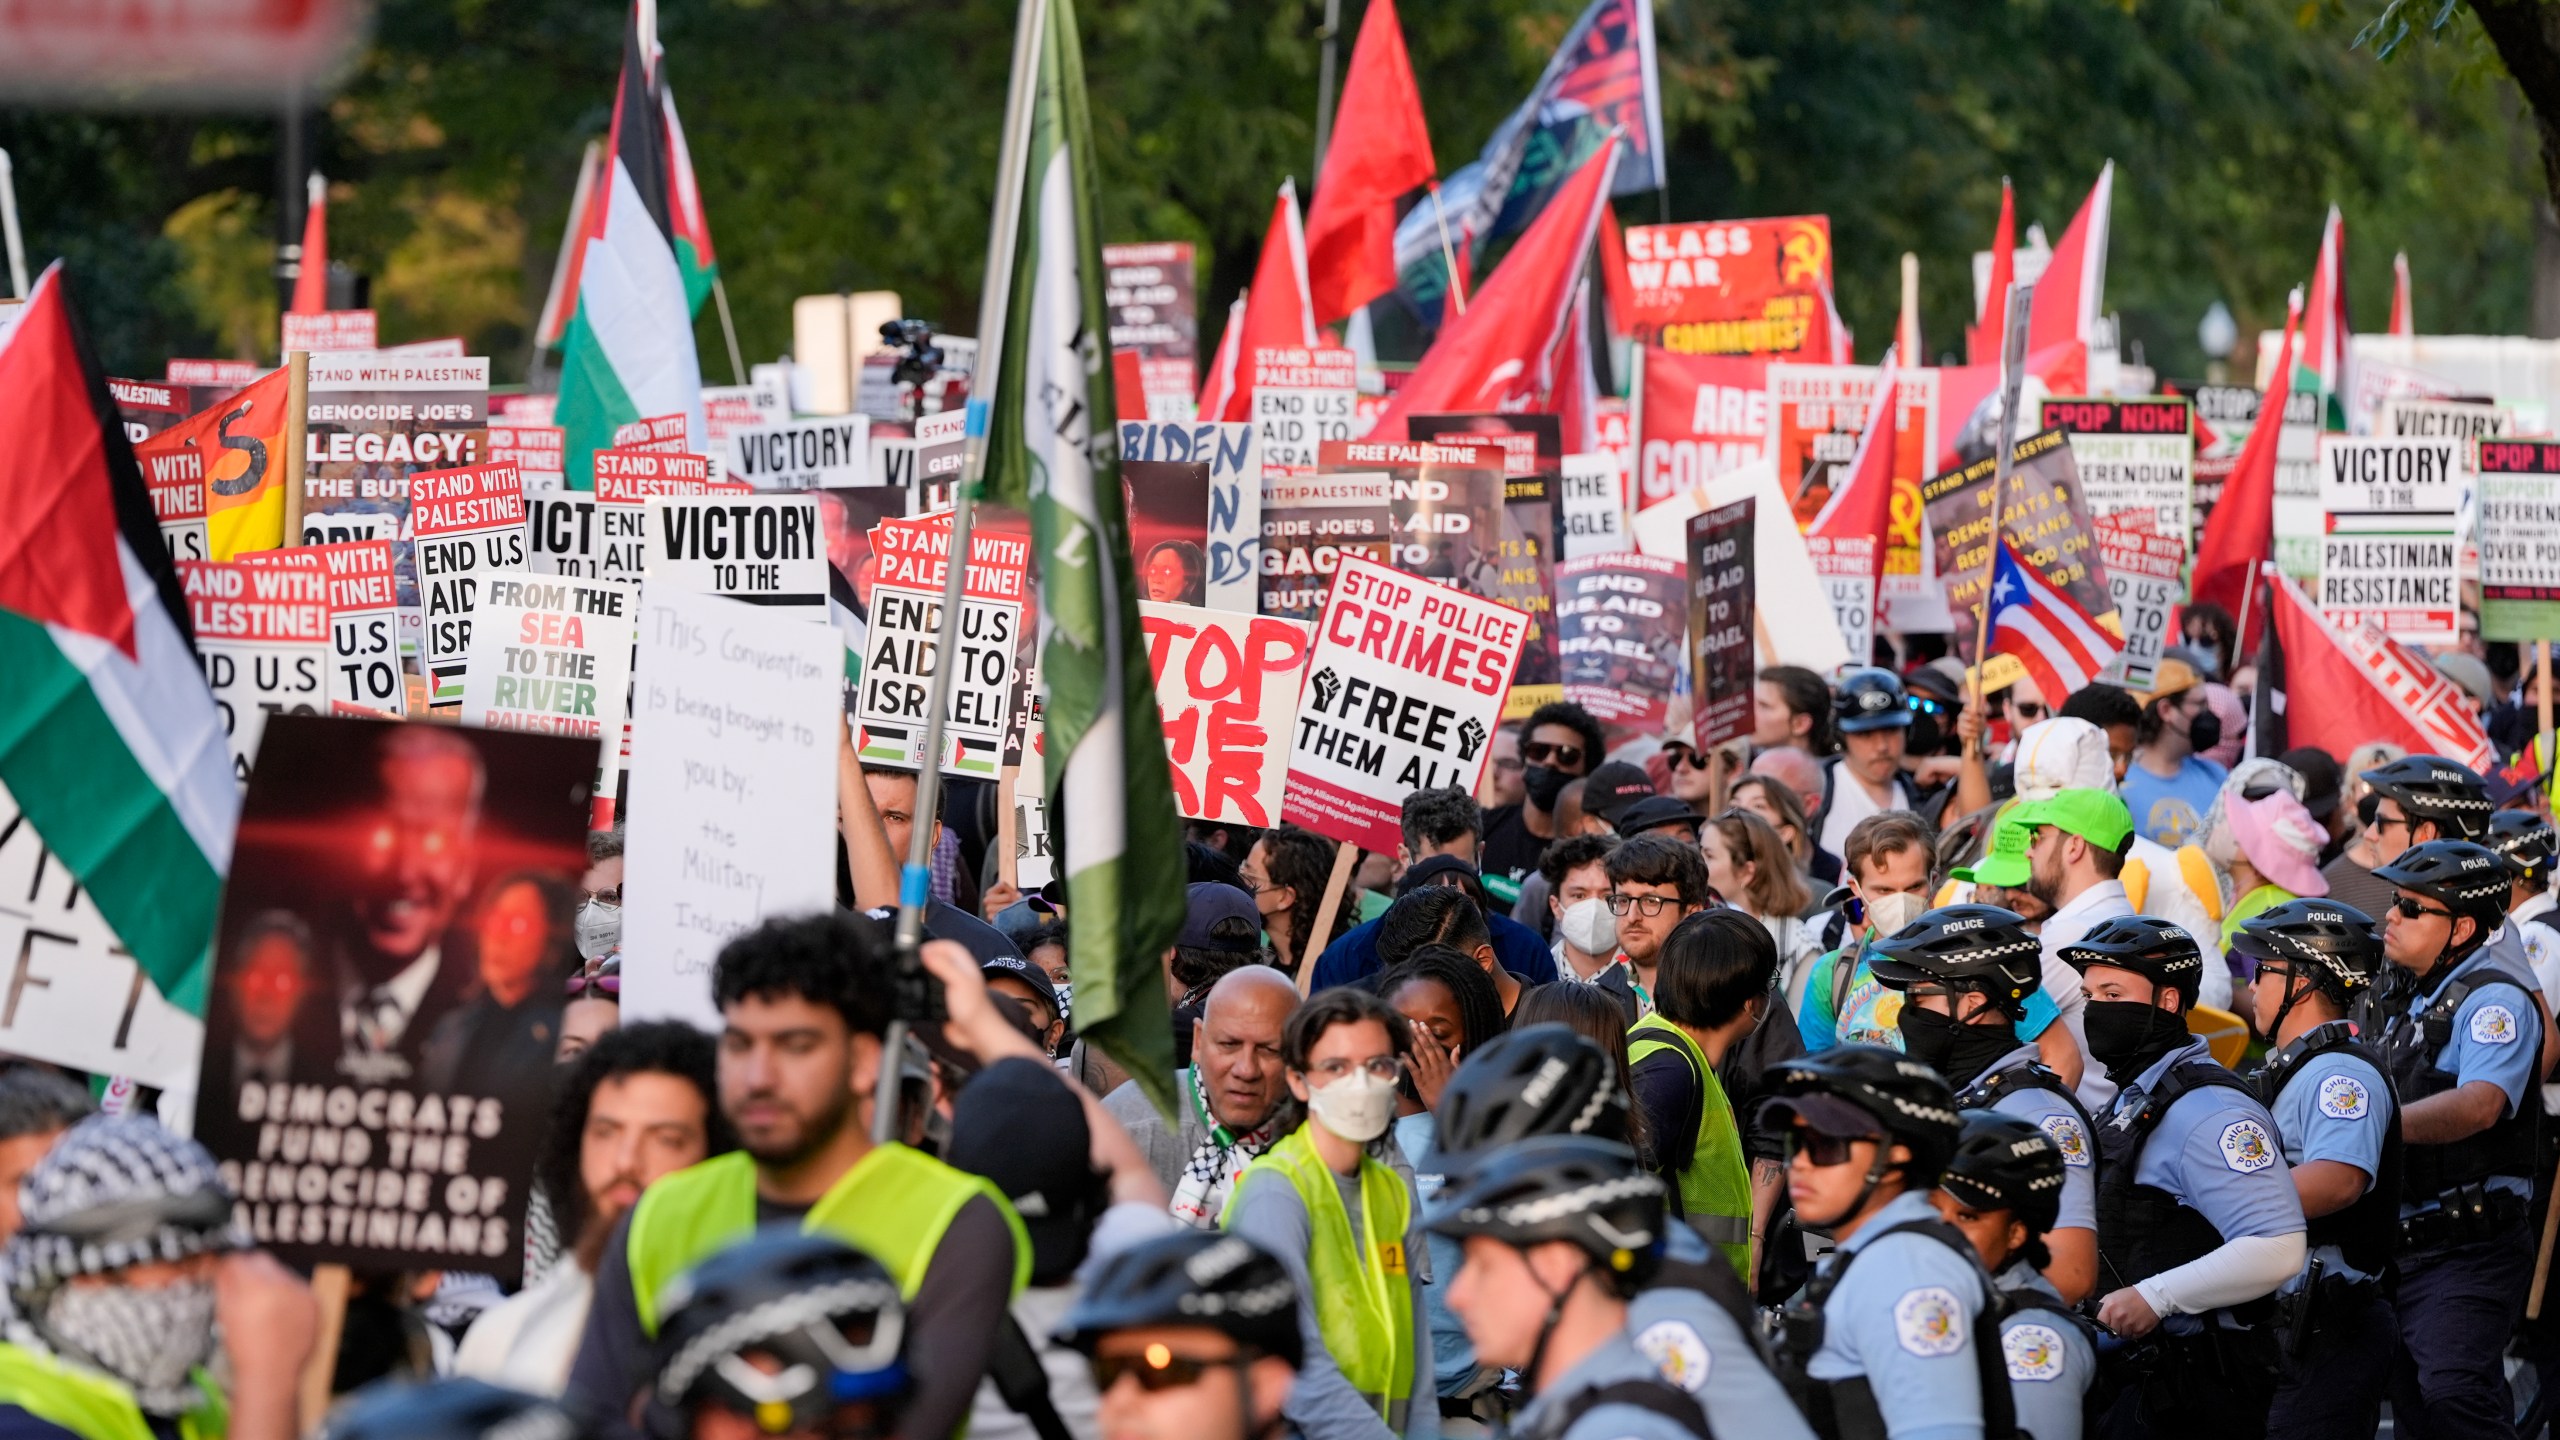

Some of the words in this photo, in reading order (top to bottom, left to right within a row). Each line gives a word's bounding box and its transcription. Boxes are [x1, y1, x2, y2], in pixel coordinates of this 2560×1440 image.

[1626, 227, 1750, 260] CLASS
[1627, 259, 1720, 288] WAR
[285, 314, 325, 330] STAND
[329, 312, 375, 329] WITH
[286, 331, 374, 348] PALESTINE!
[1256, 351, 1308, 367] STAND
[1314, 350, 1353, 367] WITH
[308, 370, 353, 382] STAND
[360, 369, 399, 381] WITH
[405, 369, 482, 381] PALESTINE
[1256, 369, 1353, 387] PALESTINE!
[308, 405, 413, 421] GENOCIDE
[418, 405, 473, 421] JOE'S
[1262, 396, 1304, 415] END
[1692, 384, 1767, 437] ARE
[2120, 403, 2186, 431] NOW!
[518, 431, 561, 448] WITH
[614, 424, 651, 446] STAND
[652, 417, 685, 440] WITH
[923, 420, 966, 438] STAND
[1262, 421, 1303, 441] AID
[1319, 421, 1349, 440] TO
[306, 433, 477, 462] LEGACY:
[741, 425, 853, 475] VICTORY
[1122, 424, 1249, 477] BIDEN
[1347, 445, 1386, 461] FREE
[1389, 446, 1476, 464] PALESTINE
[2144, 442, 2183, 459] THE
[2482, 444, 2536, 471] CPOP
[151, 453, 202, 482] WITH
[597, 456, 659, 477] STAND
[666, 460, 705, 480] WITH
[1924, 472, 1964, 500] STAND
[1965, 457, 1997, 481] WITH
[2333, 447, 2453, 483] VICTORY
[305, 479, 354, 498] THE
[413, 474, 474, 501] STAND
[479, 467, 519, 493] WITH
[1301, 485, 1383, 498] PALESTINE
[2391, 488, 2414, 505] THE
[416, 493, 523, 530] PALESTINE!
[1403, 513, 1471, 534] AID
[1947, 491, 2051, 548] DEMORATS
[662, 505, 816, 561] VICTORY
[1316, 519, 1376, 535] JOE'S
[424, 541, 476, 575] END
[486, 534, 523, 568] U.S
[882, 526, 950, 556] STAN
[973, 537, 1026, 566] WITH
[1702, 538, 1736, 567] END
[1834, 537, 1874, 554] WITH
[2145, 538, 2184, 559] WITH
[2326, 543, 2453, 569] PALESTINIAN
[326, 547, 388, 576] WITH
[879, 554, 1022, 596] PALETINE!
[1598, 553, 1675, 573] PALESTINE
[251, 571, 326, 601] WITH
[714, 564, 738, 591] TO
[748, 563, 780, 590] THE
[1577, 575, 1648, 594] END
[1717, 565, 1745, 590] AID
[2326, 578, 2453, 604] RESISTANCE
[429, 577, 477, 616] AID
[489, 580, 567, 612] FROM
[572, 586, 624, 618] THE
[1342, 570, 1411, 611] STOP
[1420, 596, 1519, 649] POLICE
[1603, 596, 1663, 619] AID
[878, 596, 943, 634] END
[961, 607, 1009, 643] U.S
[1581, 616, 1624, 632] TO
[1708, 600, 1730, 623] TO
[2134, 606, 2163, 632] TO
[335, 620, 389, 657] U.S
[519, 612, 584, 649] SEA
[653, 606, 708, 658] This
[719, 628, 823, 681] Convention
[871, 636, 939, 678] AID
[961, 646, 1006, 687] TO
[1328, 599, 1509, 697] CRIMES
[255, 656, 317, 692] U.S
[504, 646, 537, 675] TO
[544, 651, 595, 681] THE
[340, 661, 395, 701] TO
[494, 675, 597, 717] RIVER
[867, 678, 1001, 729] ISREL!
[485, 710, 600, 738] PALESTINE
[647, 683, 668, 712] is
[675, 685, 722, 739] being
[726, 703, 785, 745] brought
[793, 719, 815, 749] to
[1338, 676, 1457, 754] FREE
[1299, 716, 1388, 778] THEM
[683, 757, 718, 792] you
[2430, 769, 2463, 784] POLICE
[1294, 793, 1326, 813] Political
[1325, 806, 1372, 829] Repression
[1313, 788, 1346, 808] Alliance
[1344, 800, 1378, 819] Against
[700, 818, 737, 848] the
[2460, 857, 2491, 872] POLICE
[682, 846, 765, 922] Military
[1942, 918, 1986, 935] POLICE
[2306, 912, 2344, 924] POLICE
[2159, 928, 2188, 940] POLICE
[2478, 1030, 2511, 1040] POLICE
[2324, 1077, 2365, 1100] CHICAGO
[238, 1081, 502, 1138] DEMOCRATS
[2325, 1100, 2362, 1117] POLICE
[257, 1125, 373, 1168] FUND
[387, 1132, 470, 1175] THE
[2010, 1137, 2047, 1159] POLICE
[2226, 1123, 2266, 1151] CHICAGO
[2062, 1149, 2088, 1164] OLICE
[2235, 1149, 2272, 1168] POLICE
[219, 1164, 431, 1209] GENOCIDE
[445, 1175, 509, 1213] OF
[233, 1201, 509, 1256] ALESTINIANS
[2006, 1327, 2058, 1351] CHICAGO
[2010, 1360, 2055, 1376] POLICE
